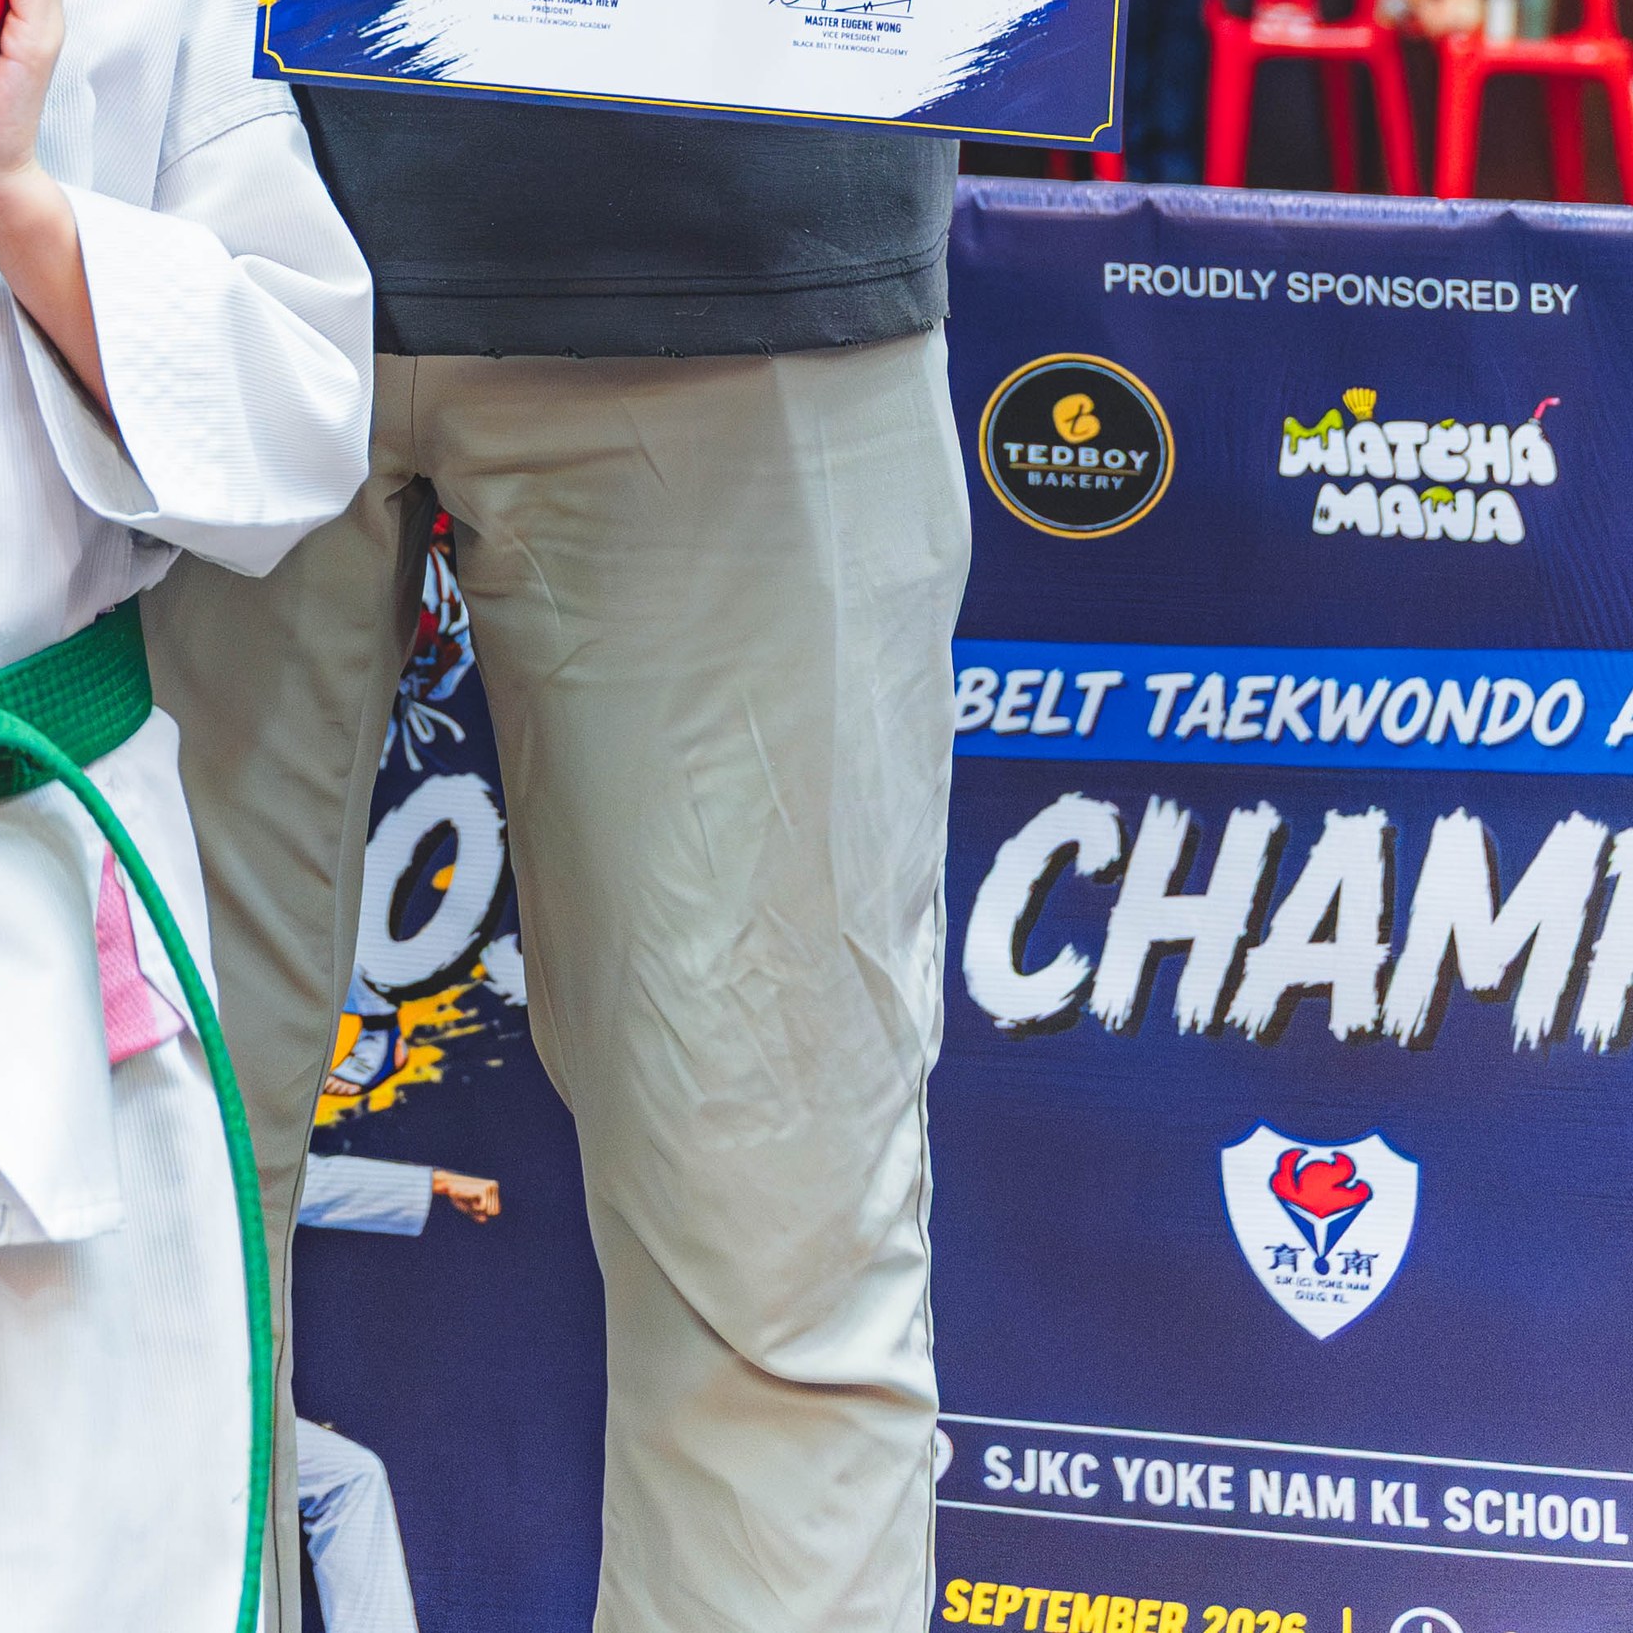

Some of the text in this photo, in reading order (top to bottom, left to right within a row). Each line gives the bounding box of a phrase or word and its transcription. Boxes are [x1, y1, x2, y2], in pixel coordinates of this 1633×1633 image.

[531, 5, 574, 16] PRESIDENT
[804, 15, 902, 34] MASTER EUGENE WONG
[822, 31, 880, 43] VICE PRESIDENT
[1104, 262, 1579, 316] PROUDLY SPONSORED BY
[1003, 442, 1149, 472] TEDBOY
[1028, 471, 1125, 491] BAKERY
[955, 666, 1124, 736] BELT
[1145, 671, 1586, 748] TAEKWONDO
[983, 1444, 1630, 1547] SJKC YOKE NAM KL SCHOOL
[941, 1578, 1189, 1633] SEPTEMBER
